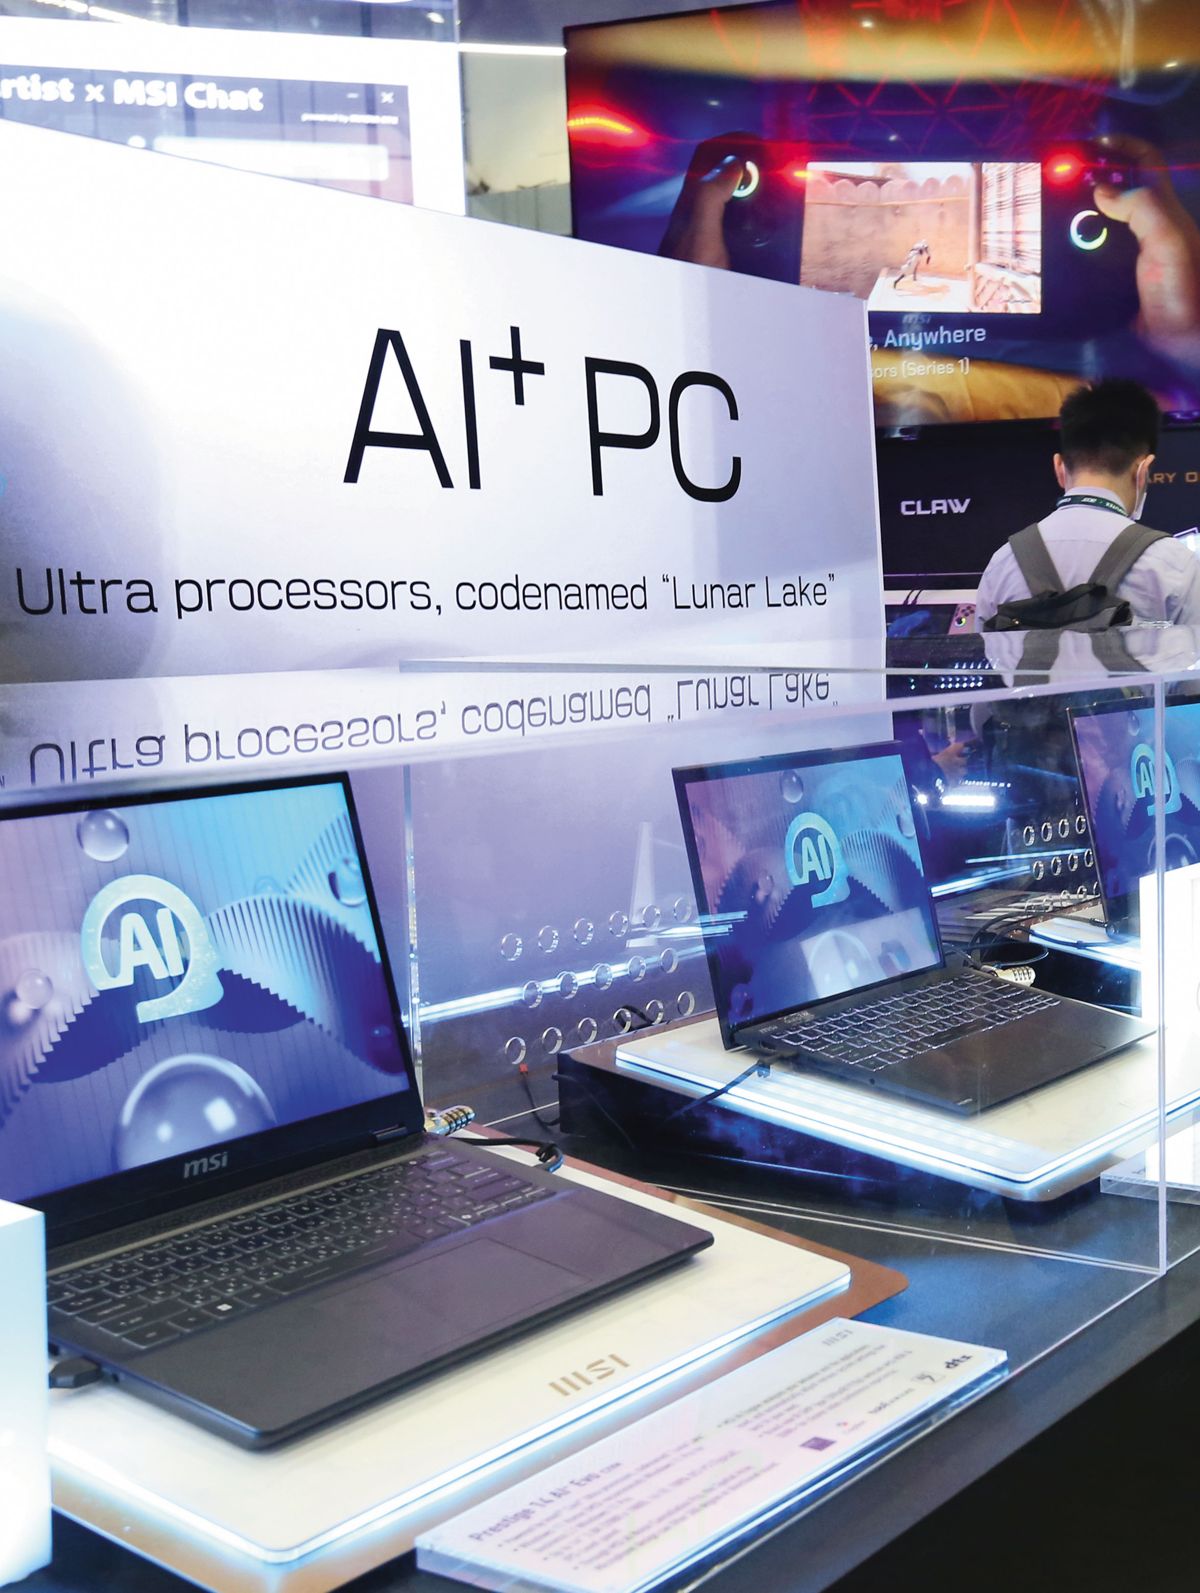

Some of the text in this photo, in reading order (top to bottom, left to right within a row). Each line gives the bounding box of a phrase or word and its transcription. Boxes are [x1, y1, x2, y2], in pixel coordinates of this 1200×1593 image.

[0, 73, 75, 102] rtist
[113, 79, 177, 107] MSI
[184, 82, 264, 111] Chat
[884, 326, 987, 351] Anywhere
[584, 356, 742, 503] PC
[900, 498, 971, 515] CLAW
[16, 567, 158, 615] Ultra
[174, 578, 442, 619] processors,
[456, 574, 648, 611] codenamed
[183, 1152, 228, 1179] msi
